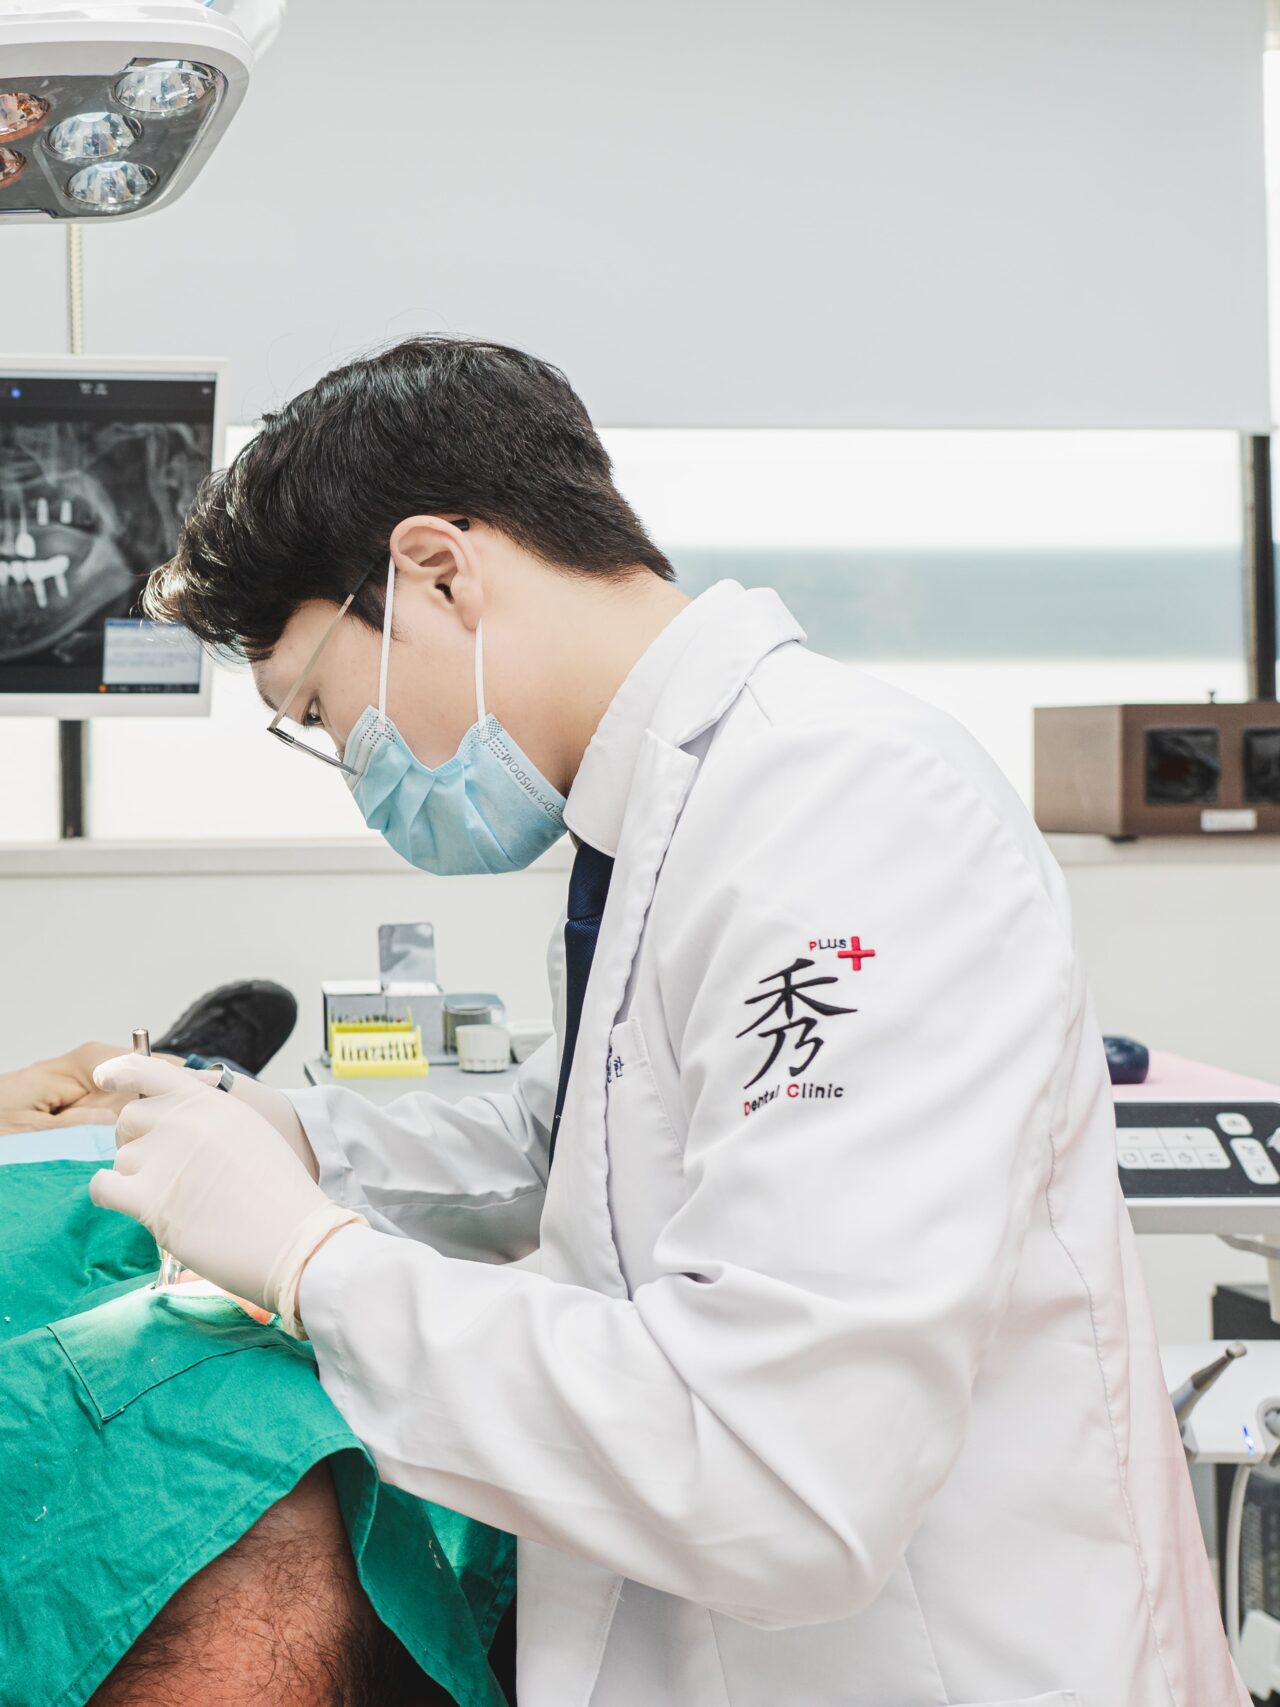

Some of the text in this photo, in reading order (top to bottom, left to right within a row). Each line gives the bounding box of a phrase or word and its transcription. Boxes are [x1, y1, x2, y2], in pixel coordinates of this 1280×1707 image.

[501, 753, 538, 798] WISDOM
[736, 958, 858, 1089] 秀
[744, 1083, 844, 1116] Dental Clinic
